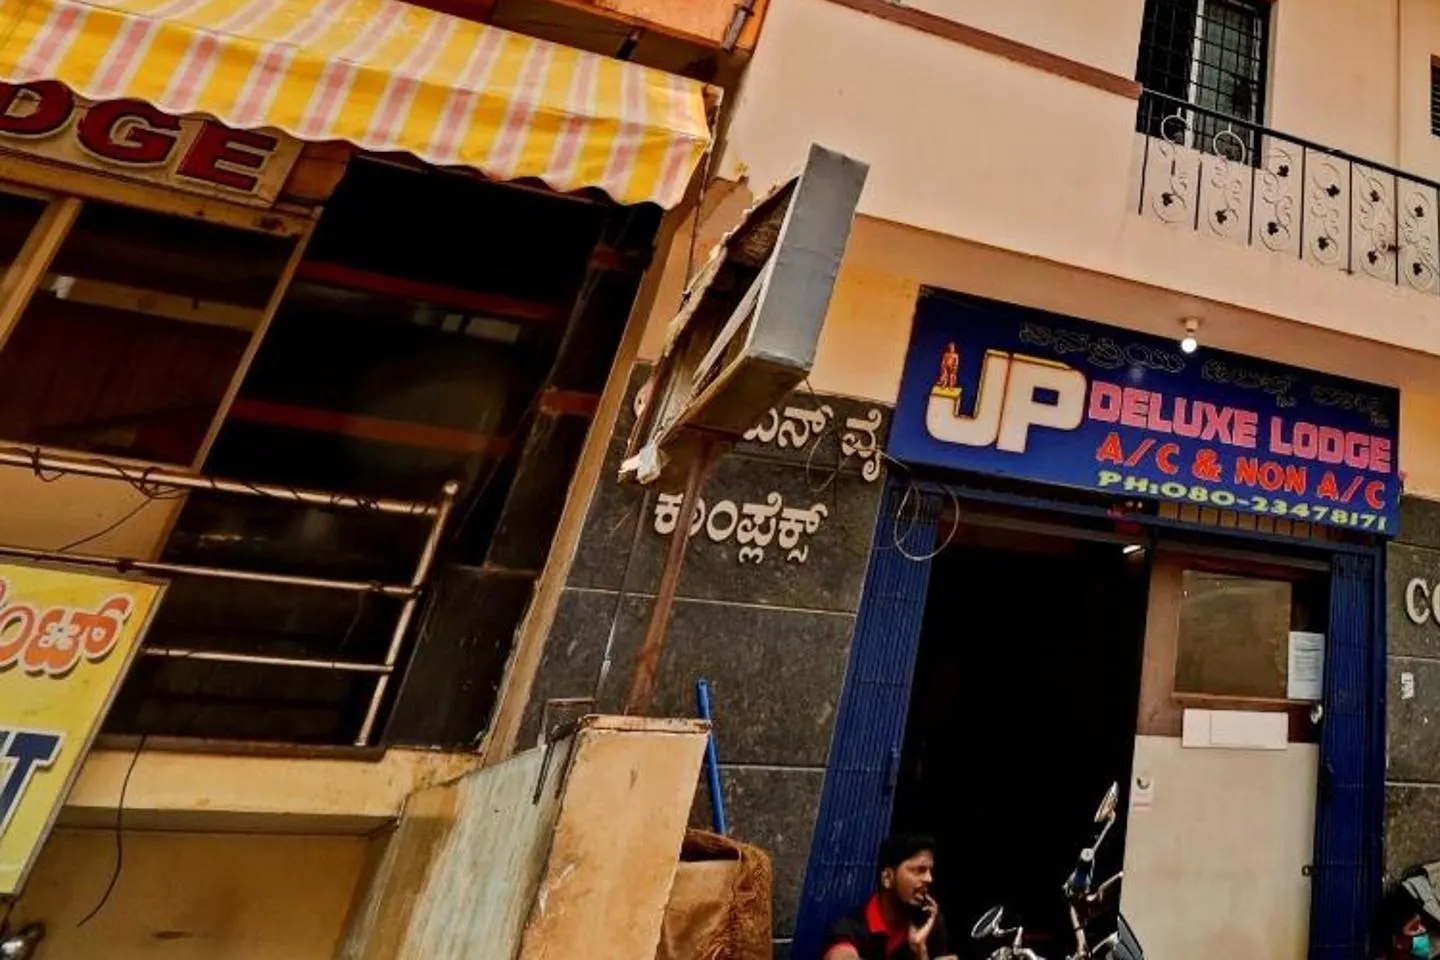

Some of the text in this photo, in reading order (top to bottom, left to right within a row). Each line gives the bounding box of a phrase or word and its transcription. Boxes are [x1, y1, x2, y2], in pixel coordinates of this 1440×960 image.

[926, 348, 1087, 454] JP
[1088, 380, 1261, 449] DELUXE
[1269, 415, 1391, 474] LODGE
[1095, 431, 1387, 510] A/C & NON A/C
